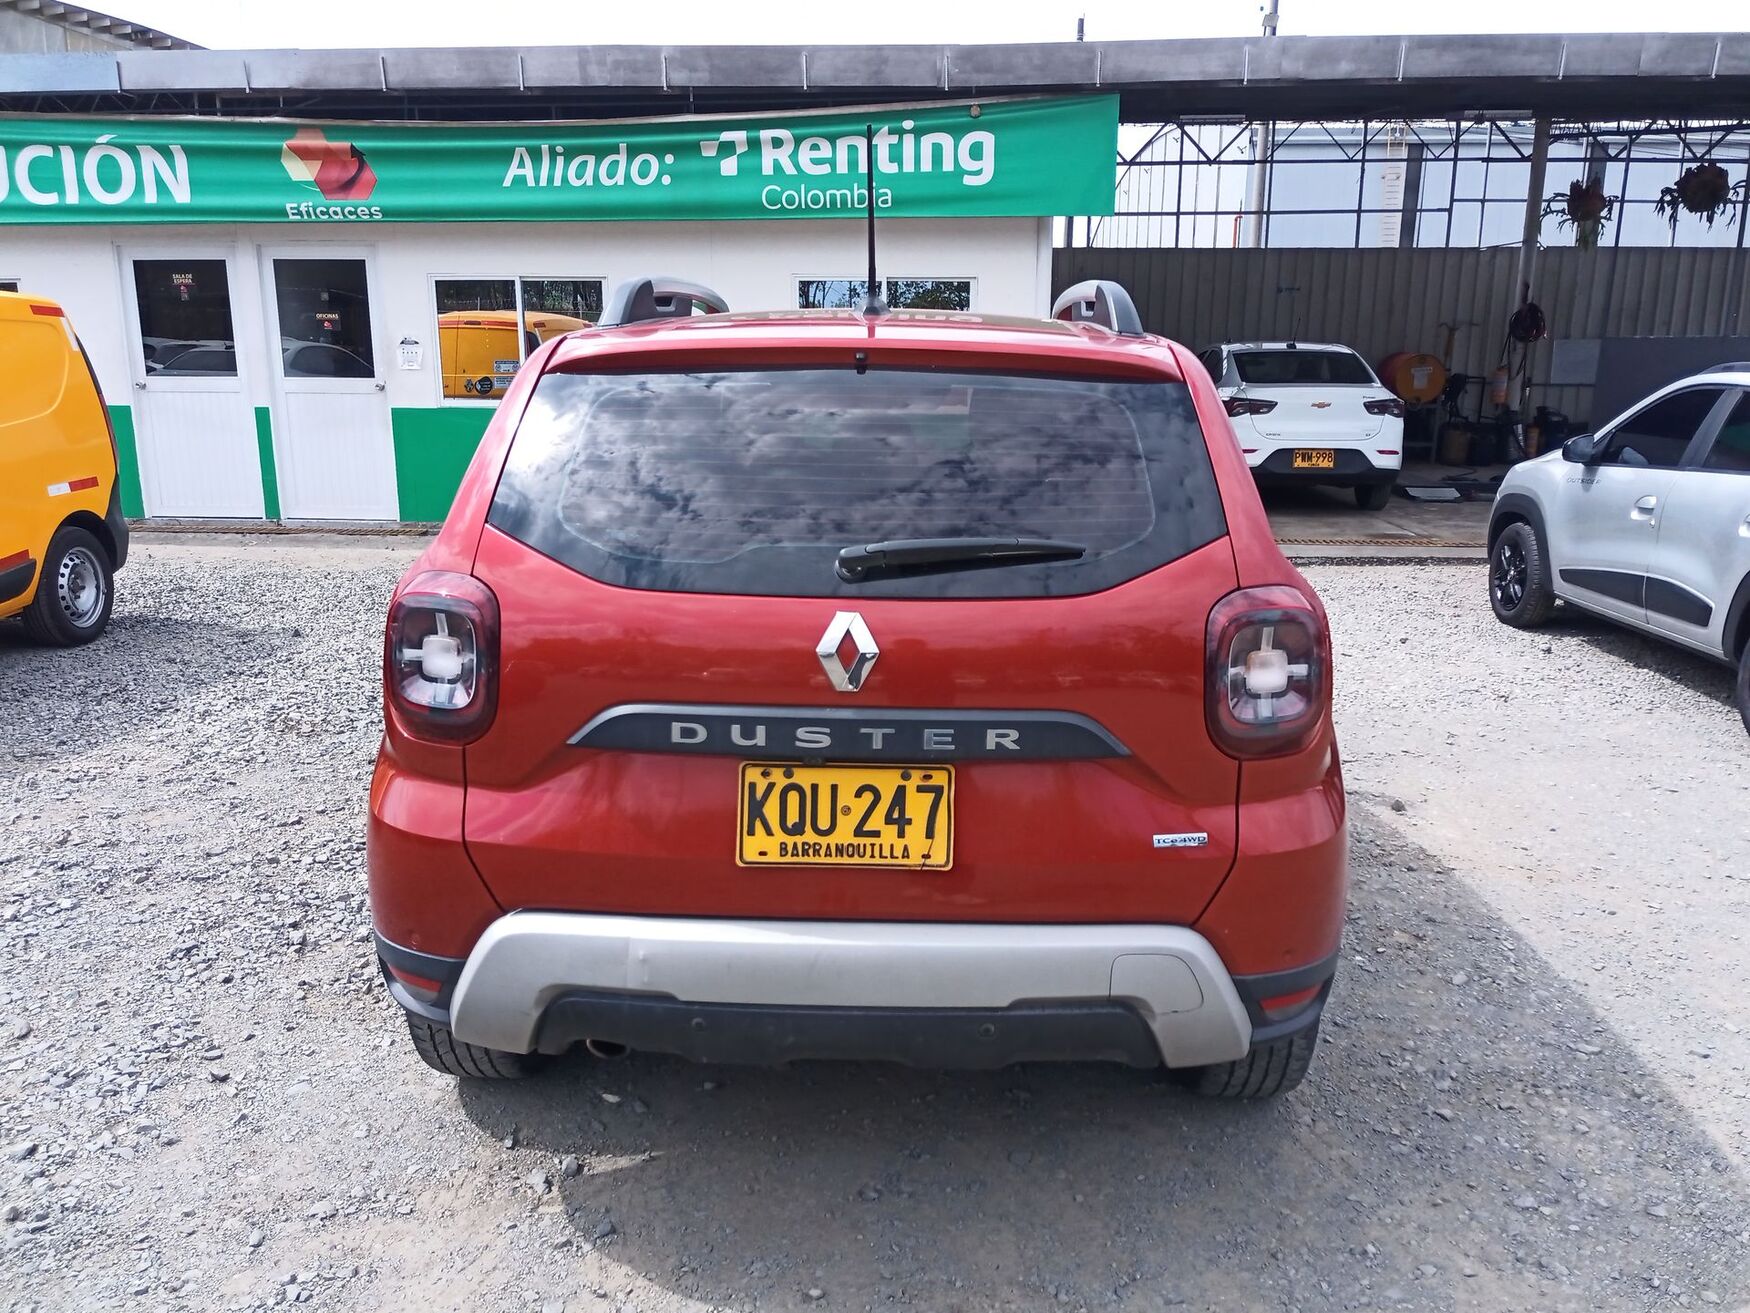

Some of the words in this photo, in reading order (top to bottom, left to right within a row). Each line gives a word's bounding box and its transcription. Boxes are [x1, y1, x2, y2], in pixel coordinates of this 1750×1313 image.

[502, 143, 675, 187] Aliado:
[759, 119, 996, 186] Renting
[761, 181, 892, 210] Colombia
[285, 201, 383, 220] Eficaces
[671, 721, 1021, 751] DUSTER
[778, 841, 911, 861] BARRANQUILLA
